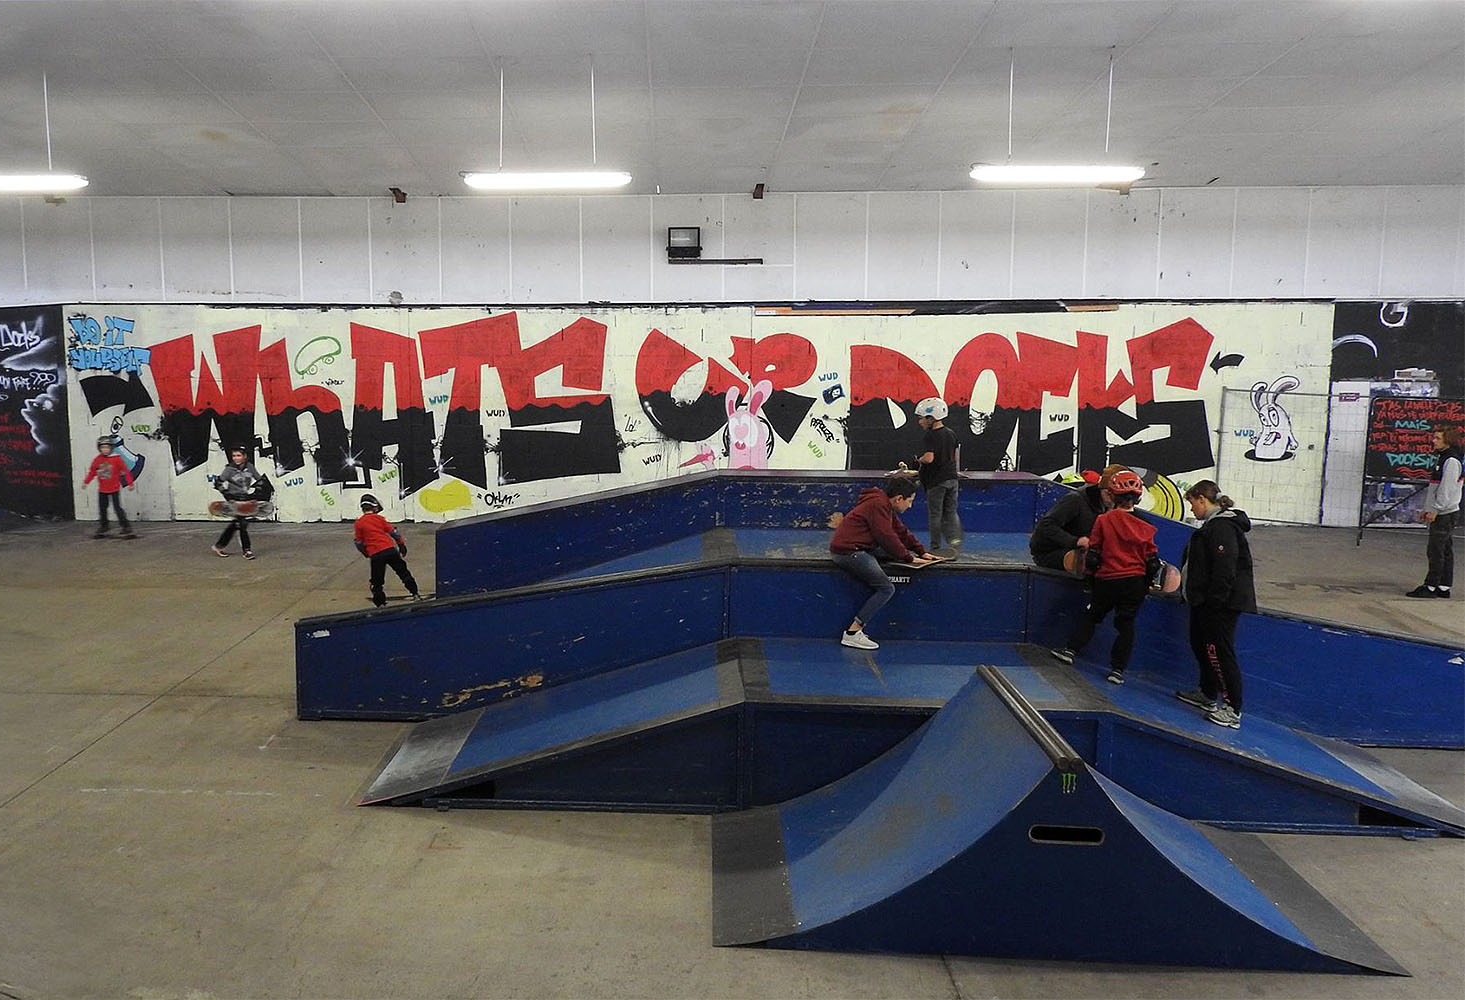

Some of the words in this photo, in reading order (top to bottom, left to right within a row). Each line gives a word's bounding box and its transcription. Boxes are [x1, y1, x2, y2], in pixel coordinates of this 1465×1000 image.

[68, 346, 152, 376] YOURSELF
[818, 371, 839, 382] WUD
[428, 394, 450, 405] WUD
[1048, 413, 1071, 422] WUD
[1234, 428, 1256, 438] WUD
[642, 453, 662, 466] WUD
[284, 476, 305, 488] WUD
